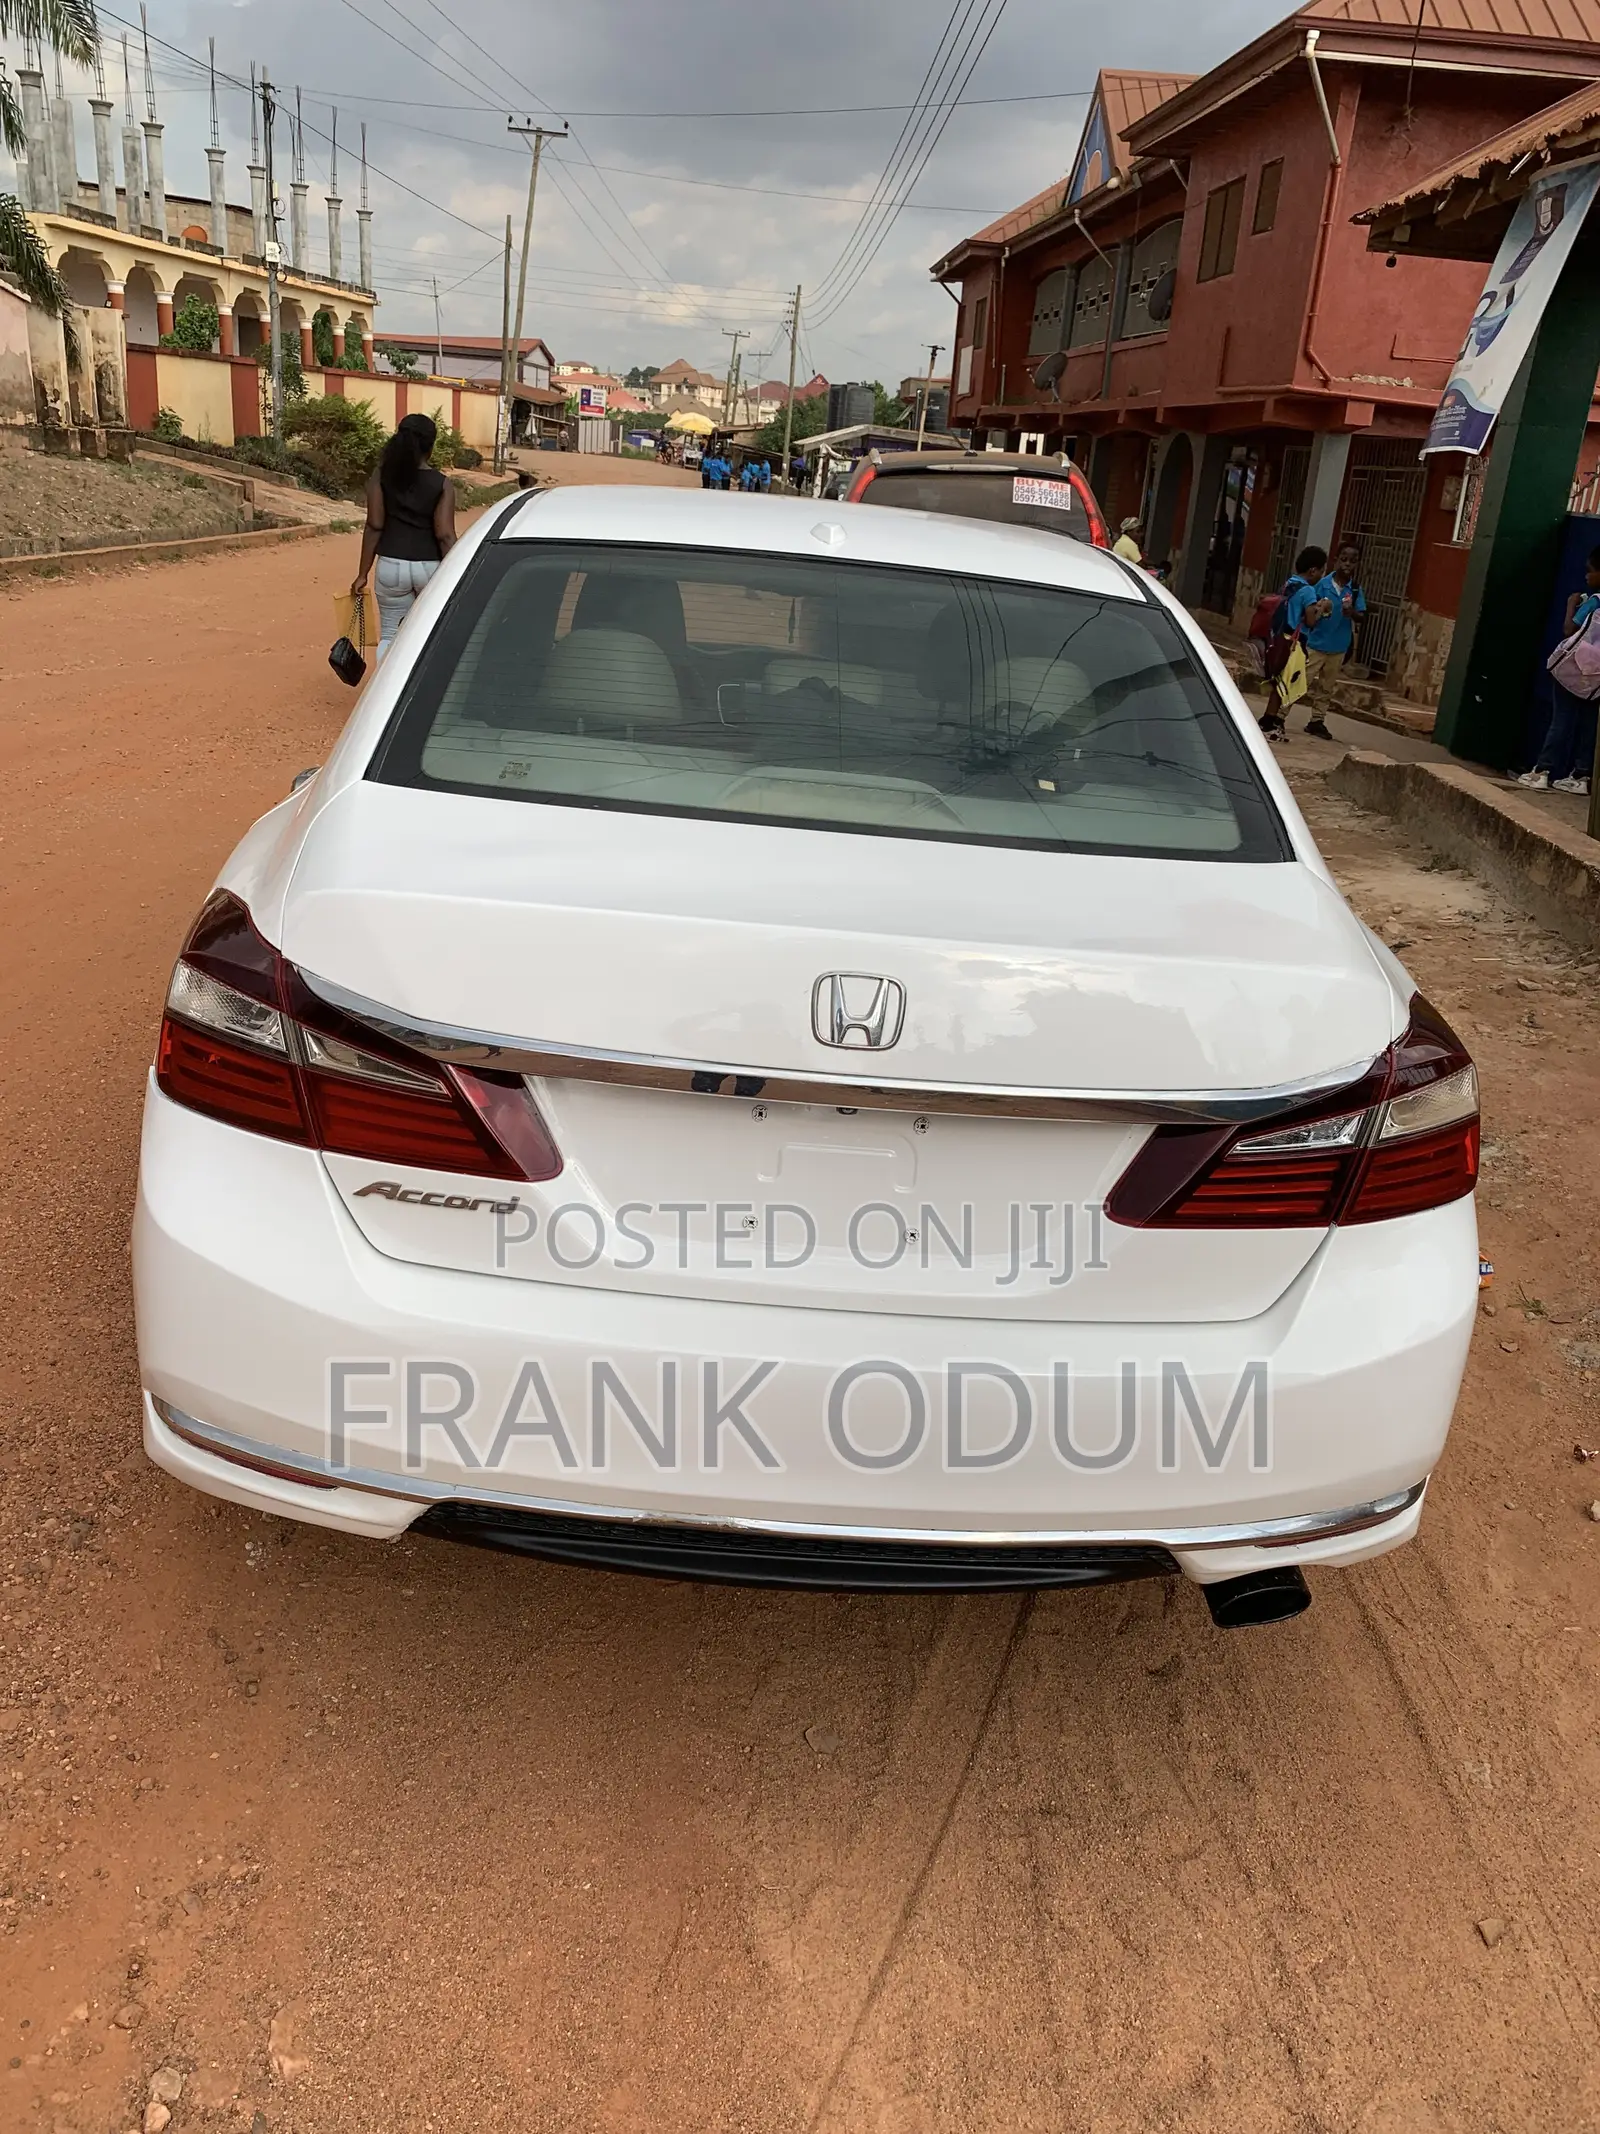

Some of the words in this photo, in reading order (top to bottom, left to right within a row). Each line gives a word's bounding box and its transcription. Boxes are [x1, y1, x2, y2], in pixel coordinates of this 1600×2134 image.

[1014, 485, 1069, 500] 0546-566198
[1016, 478, 1044, 487] BUY
[1048, 482, 1068, 492] ME
[353, 1180, 520, 1215] Accord
